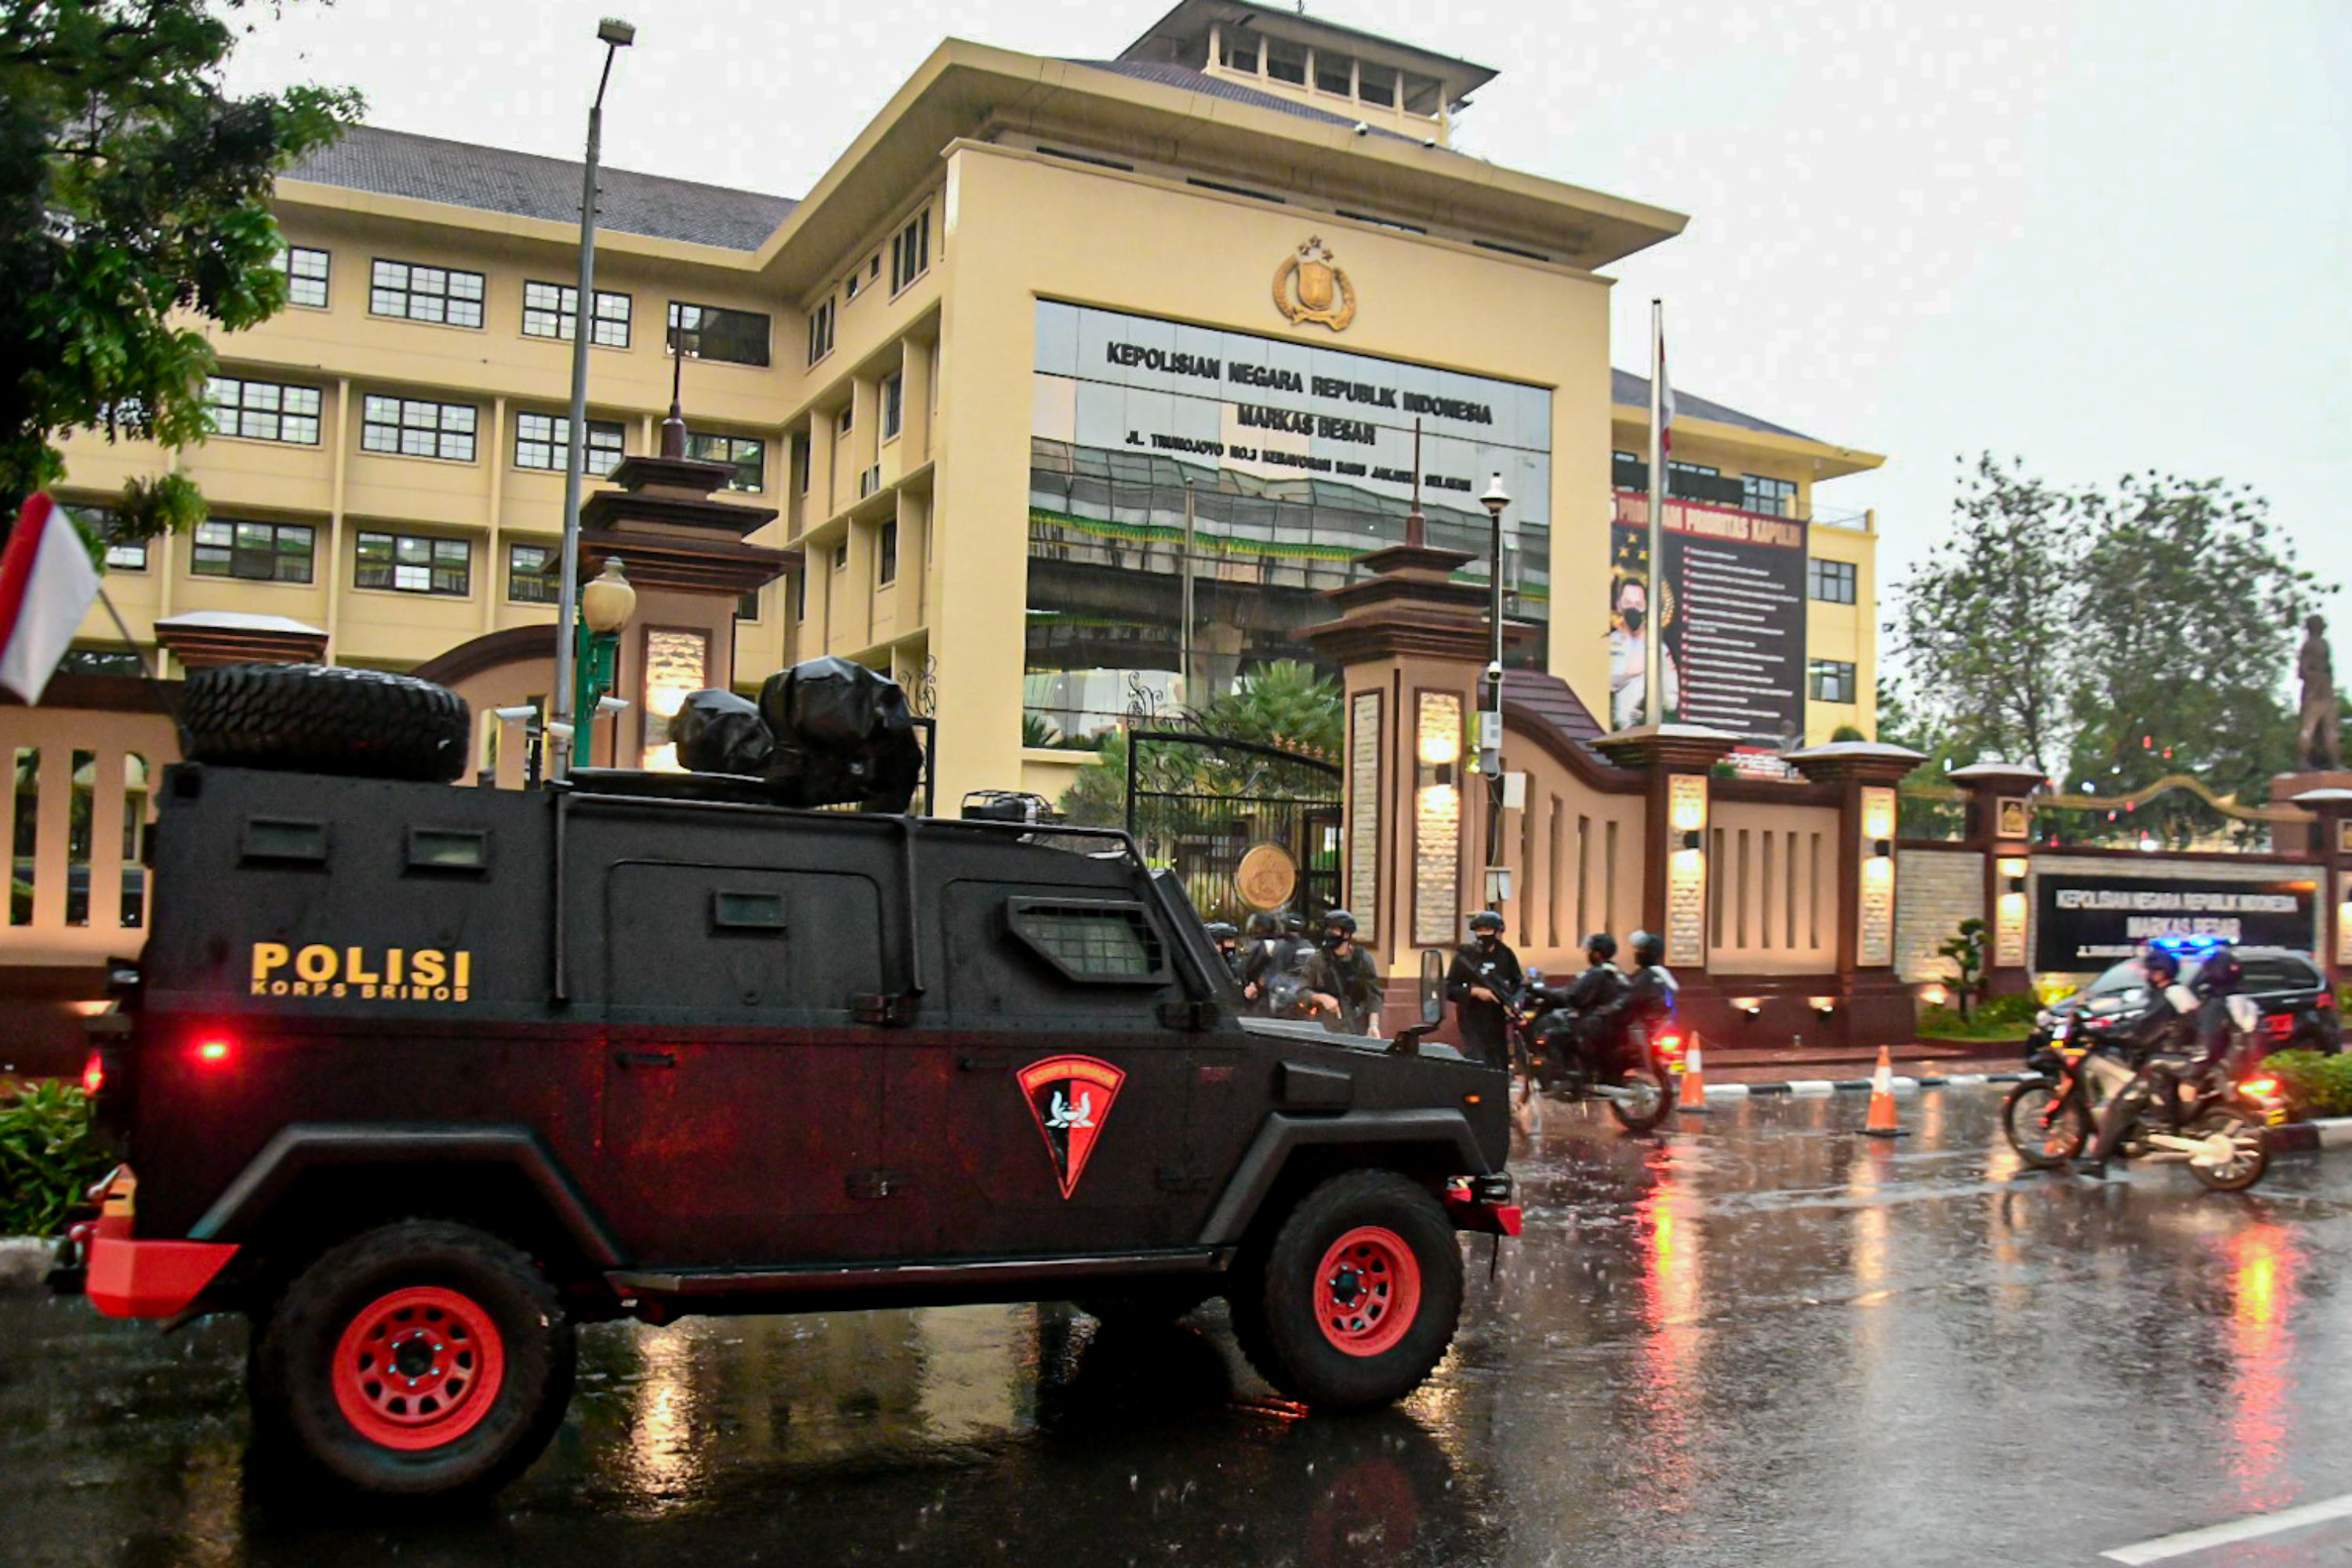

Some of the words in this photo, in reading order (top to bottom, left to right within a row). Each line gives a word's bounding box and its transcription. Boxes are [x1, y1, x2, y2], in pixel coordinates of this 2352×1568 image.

[1106, 341, 1221, 380] KEPOLISIAN
[1228, 361, 1303, 394] NEGARA
[1311, 376, 1397, 409] REPUBLIK
[1403, 391, 1493, 425] INDONESIA
[1237, 403, 1315, 436] MARKAS
[1317, 416, 1376, 445] BESAR
[252, 942, 470, 988] POLISI
[251, 981, 347, 996] KORPS
[361, 984, 469, 1001] BRIMOB
